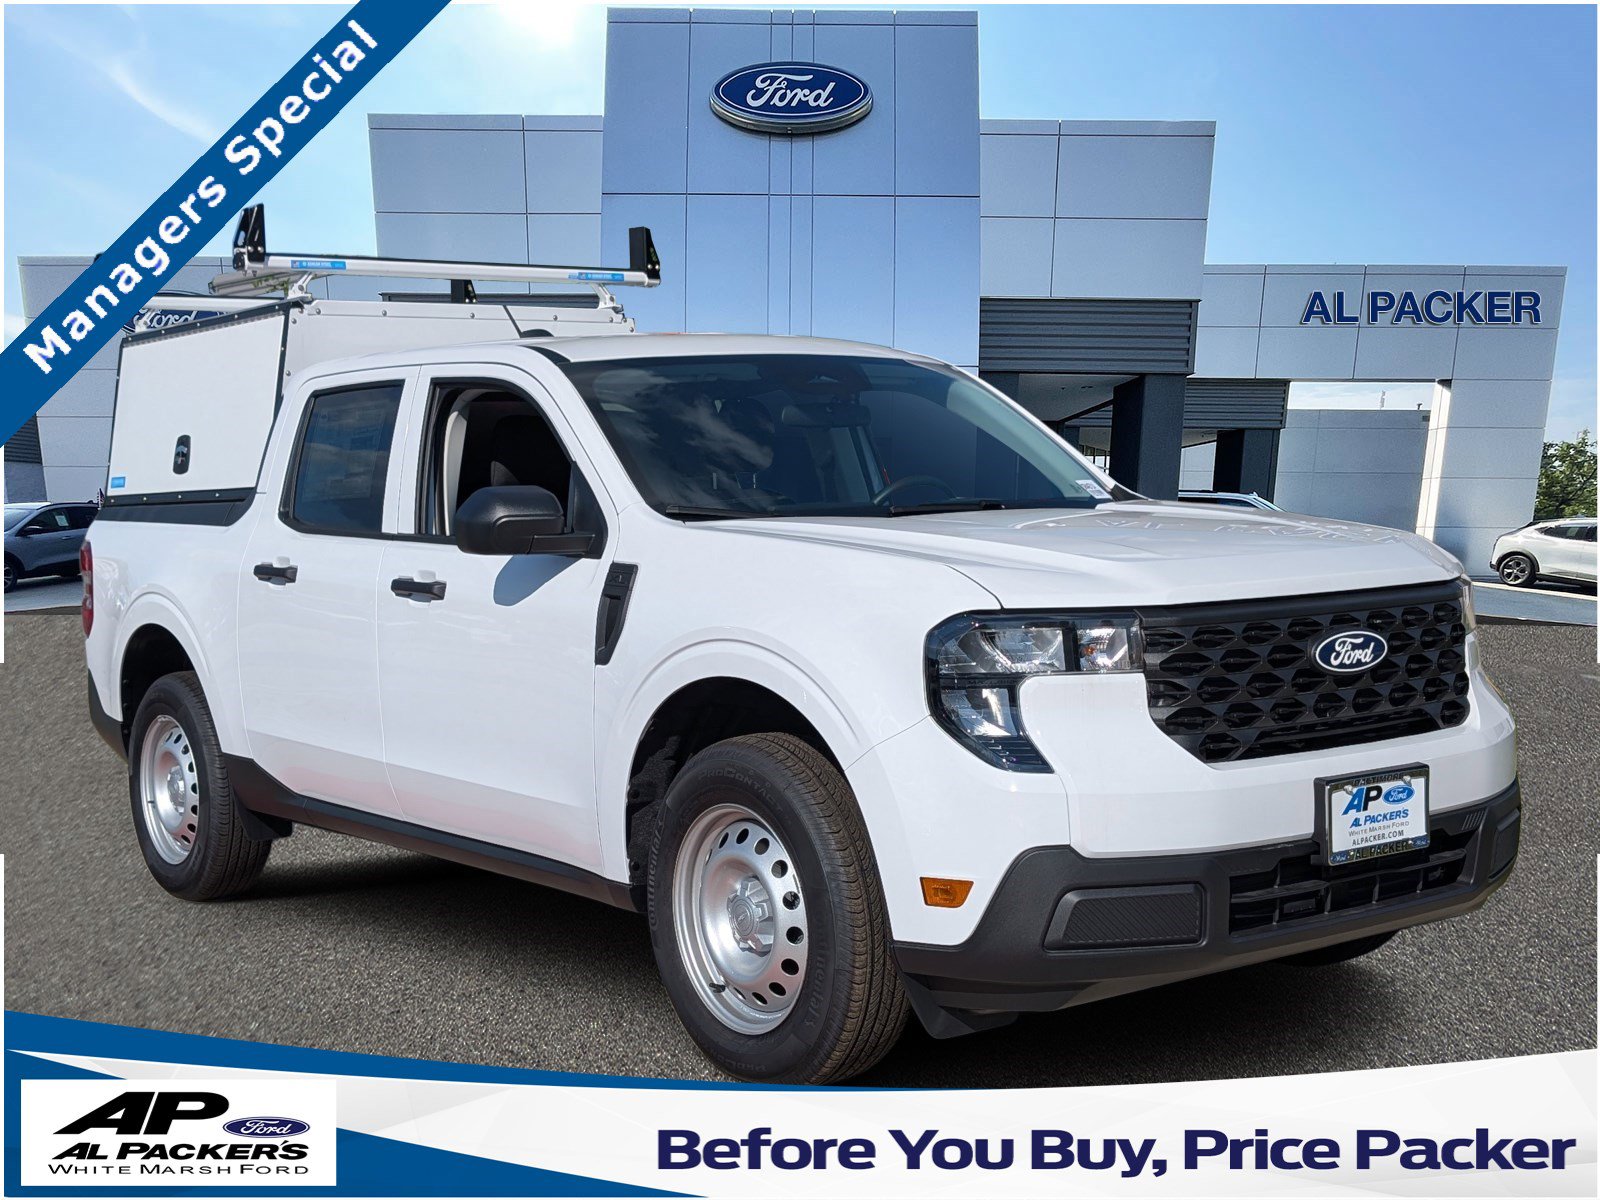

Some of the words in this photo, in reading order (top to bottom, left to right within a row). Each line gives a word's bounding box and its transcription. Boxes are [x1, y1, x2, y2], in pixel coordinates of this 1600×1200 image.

[746, 73, 836, 107] Ford
[1302, 290, 1360, 324] AL
[1369, 290, 1542, 324] PACKER
[1330, 637, 1375, 666] Ford
[1341, 785, 1383, 816] AP
[1388, 788, 1409, 801] Ford
[1348, 829, 1368, 837] WHITE
[1369, 824, 1391, 833] MARSH
[1391, 821, 1410, 829] FORD
[1349, 817, 1362, 829] AL
[1351, 829, 1405, 846] ALPACKER.COM
